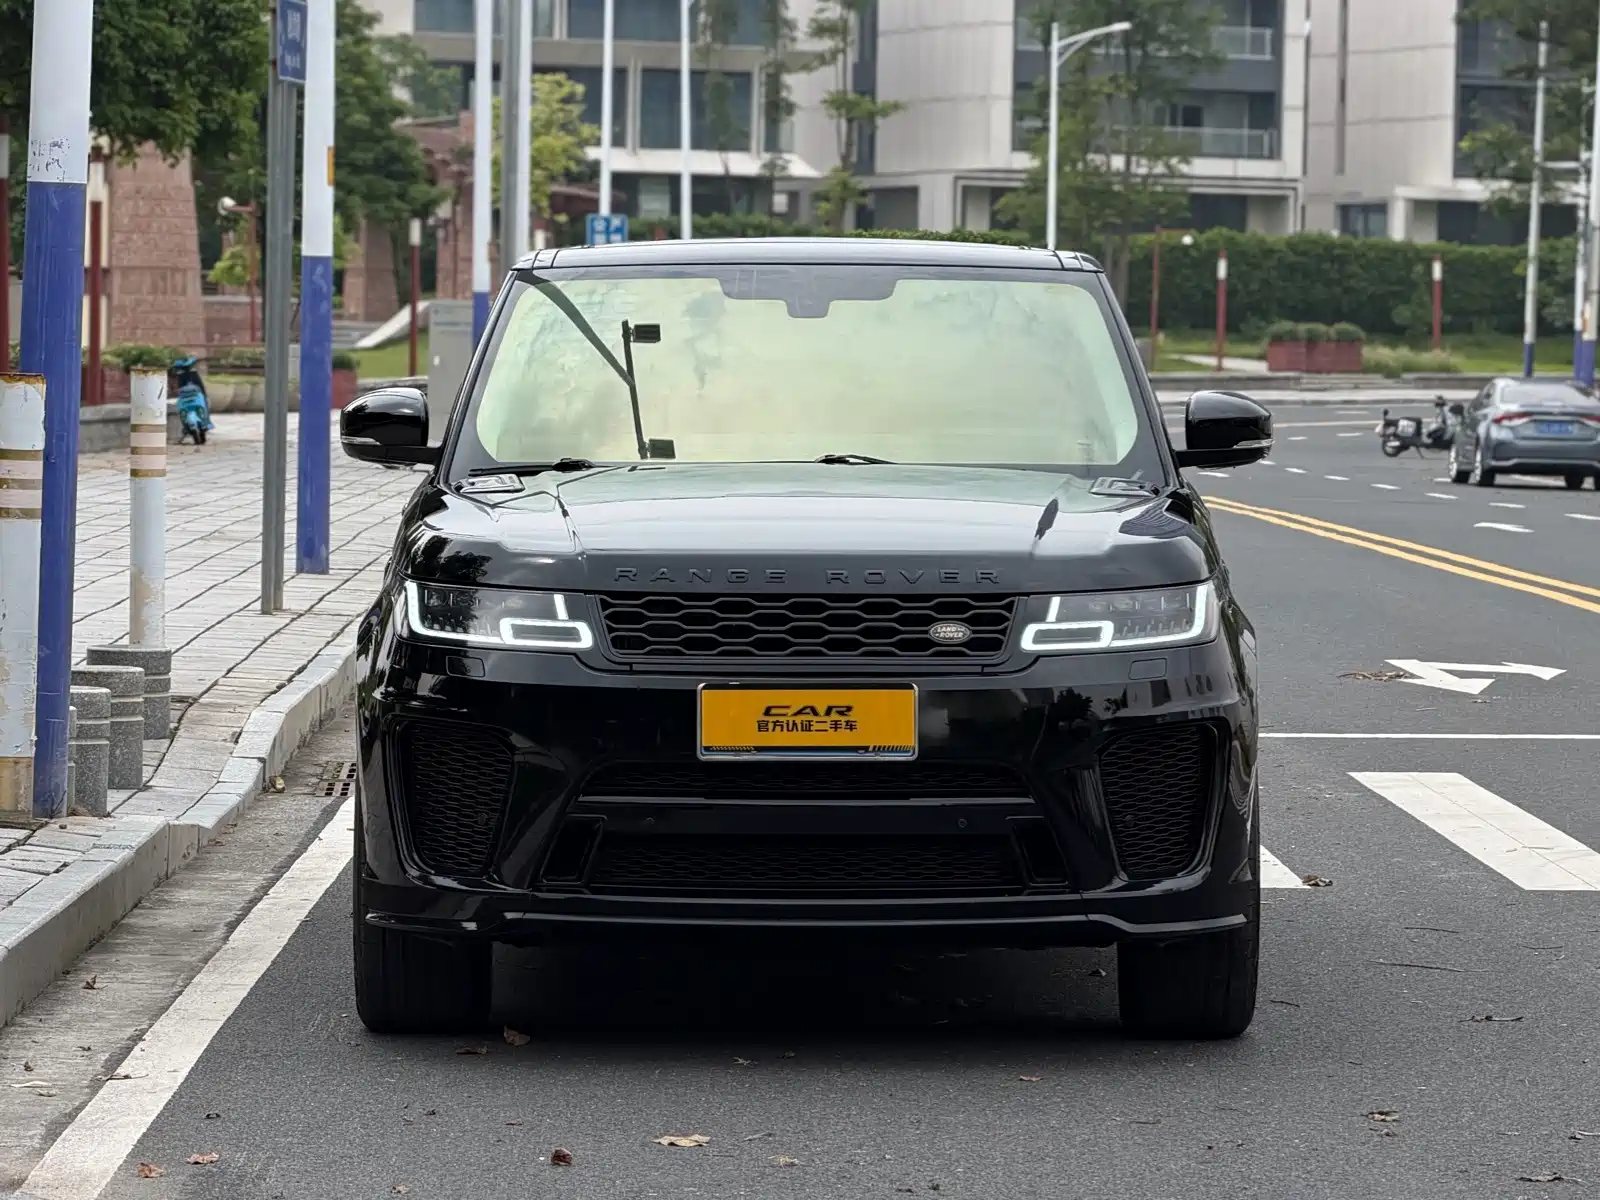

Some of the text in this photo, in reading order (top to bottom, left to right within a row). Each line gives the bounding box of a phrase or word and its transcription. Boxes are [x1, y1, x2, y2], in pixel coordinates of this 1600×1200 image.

[614, 567, 1001, 585] RANGE ROVER
[763, 705, 854, 717] CAR
[756, 719, 858, 732] 官方认证二手车
